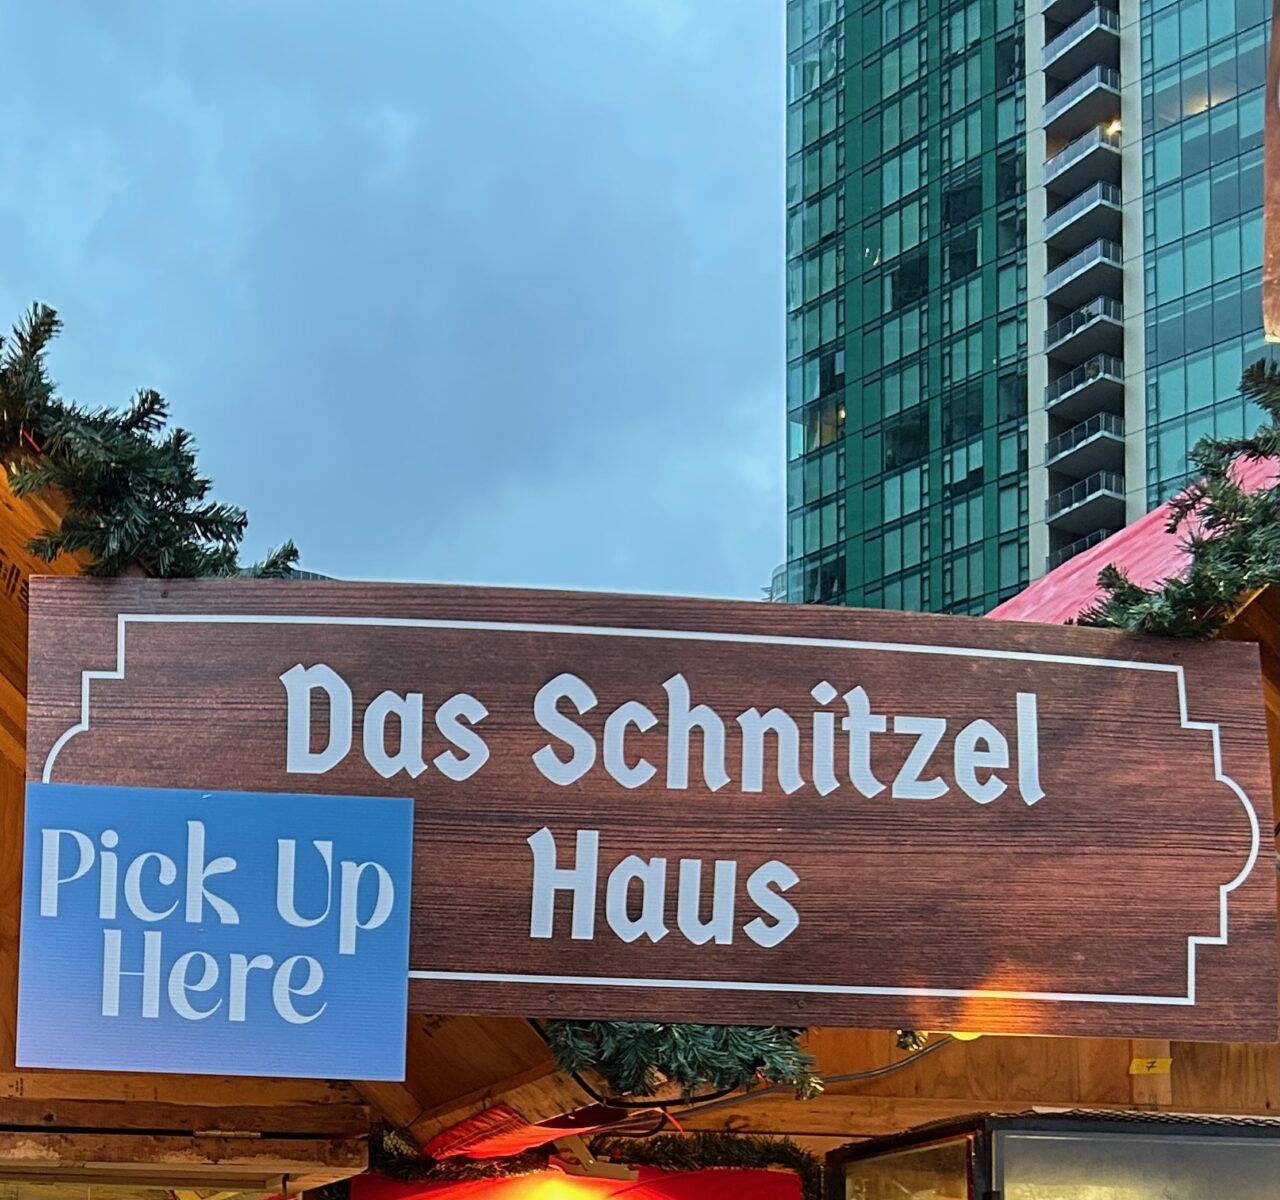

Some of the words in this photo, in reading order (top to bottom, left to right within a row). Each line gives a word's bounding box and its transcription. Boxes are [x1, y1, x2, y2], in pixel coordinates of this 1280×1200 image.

[278, 662, 491, 782] Das
[533, 672, 1046, 805] Schnitzel
[40, 820, 240, 925] Pick
[278, 838, 394, 956] Up
[527, 825, 800, 948] Haus
[102, 928, 327, 1024] Here
